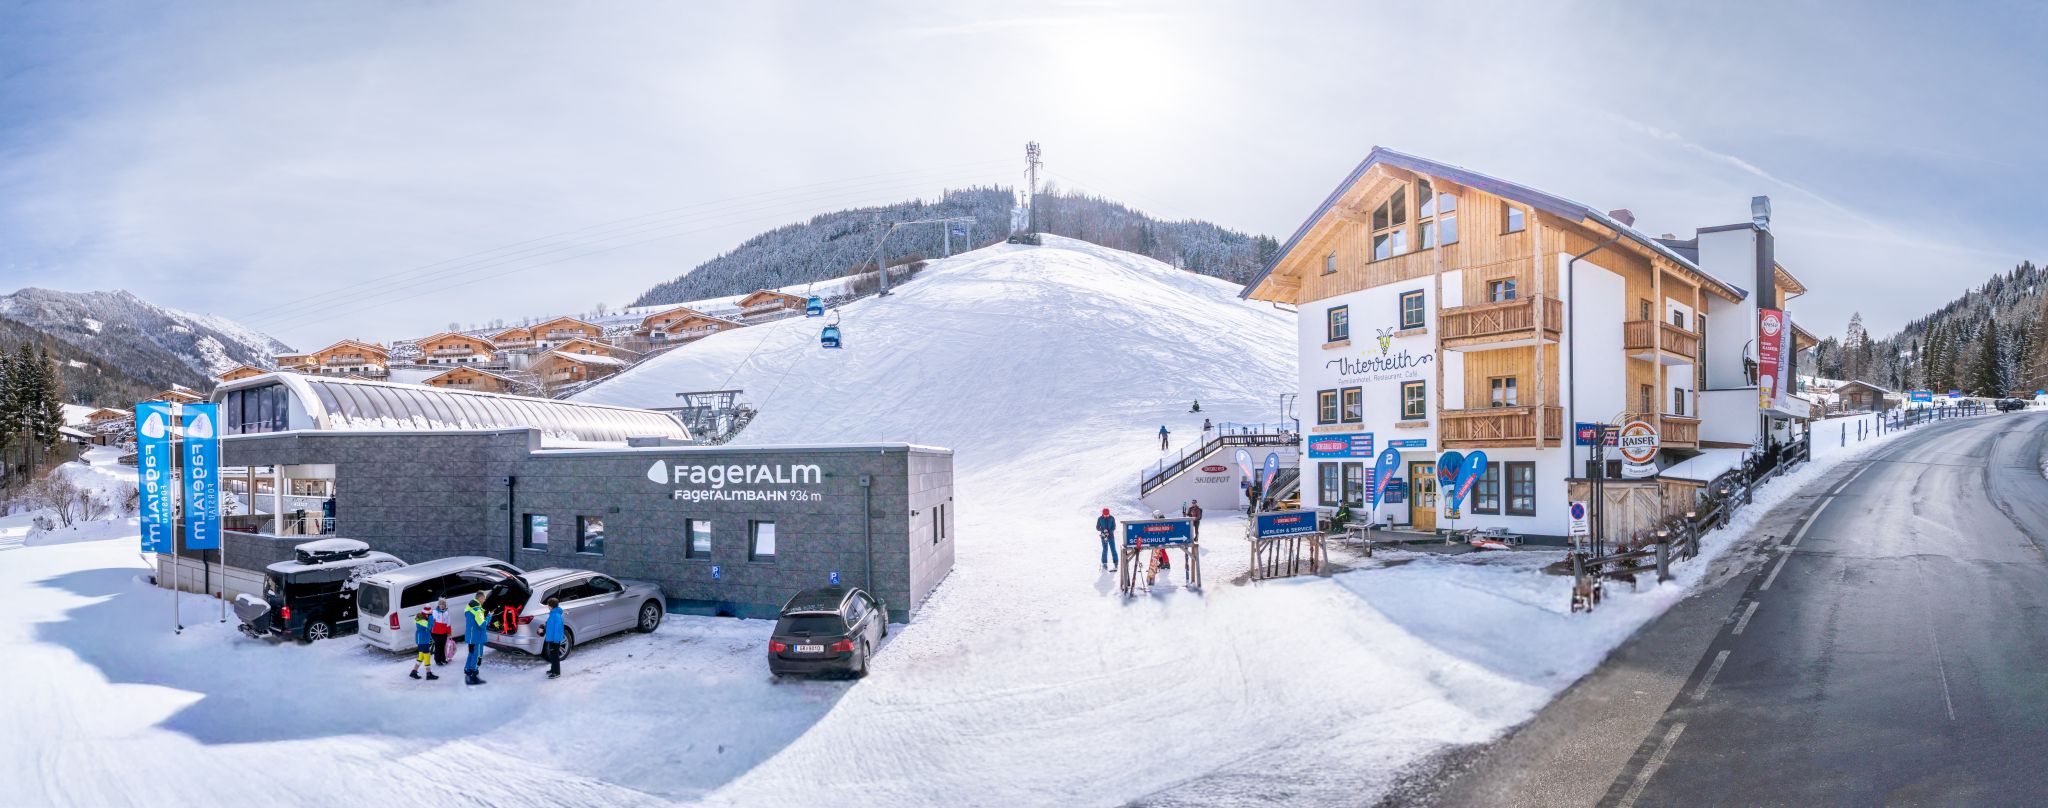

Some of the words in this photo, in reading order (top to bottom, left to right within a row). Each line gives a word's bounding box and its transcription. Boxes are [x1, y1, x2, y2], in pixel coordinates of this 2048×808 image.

[1326, 349, 1433, 375] Unterreith
[1622, 436, 1655, 447] KAISER
[1269, 457, 1275, 467] 3
[1385, 453, 1393, 465] 2
[1472, 456, 1479, 469] 1
[789, 490, 809, 501] 936
[811, 493, 822, 501] m
